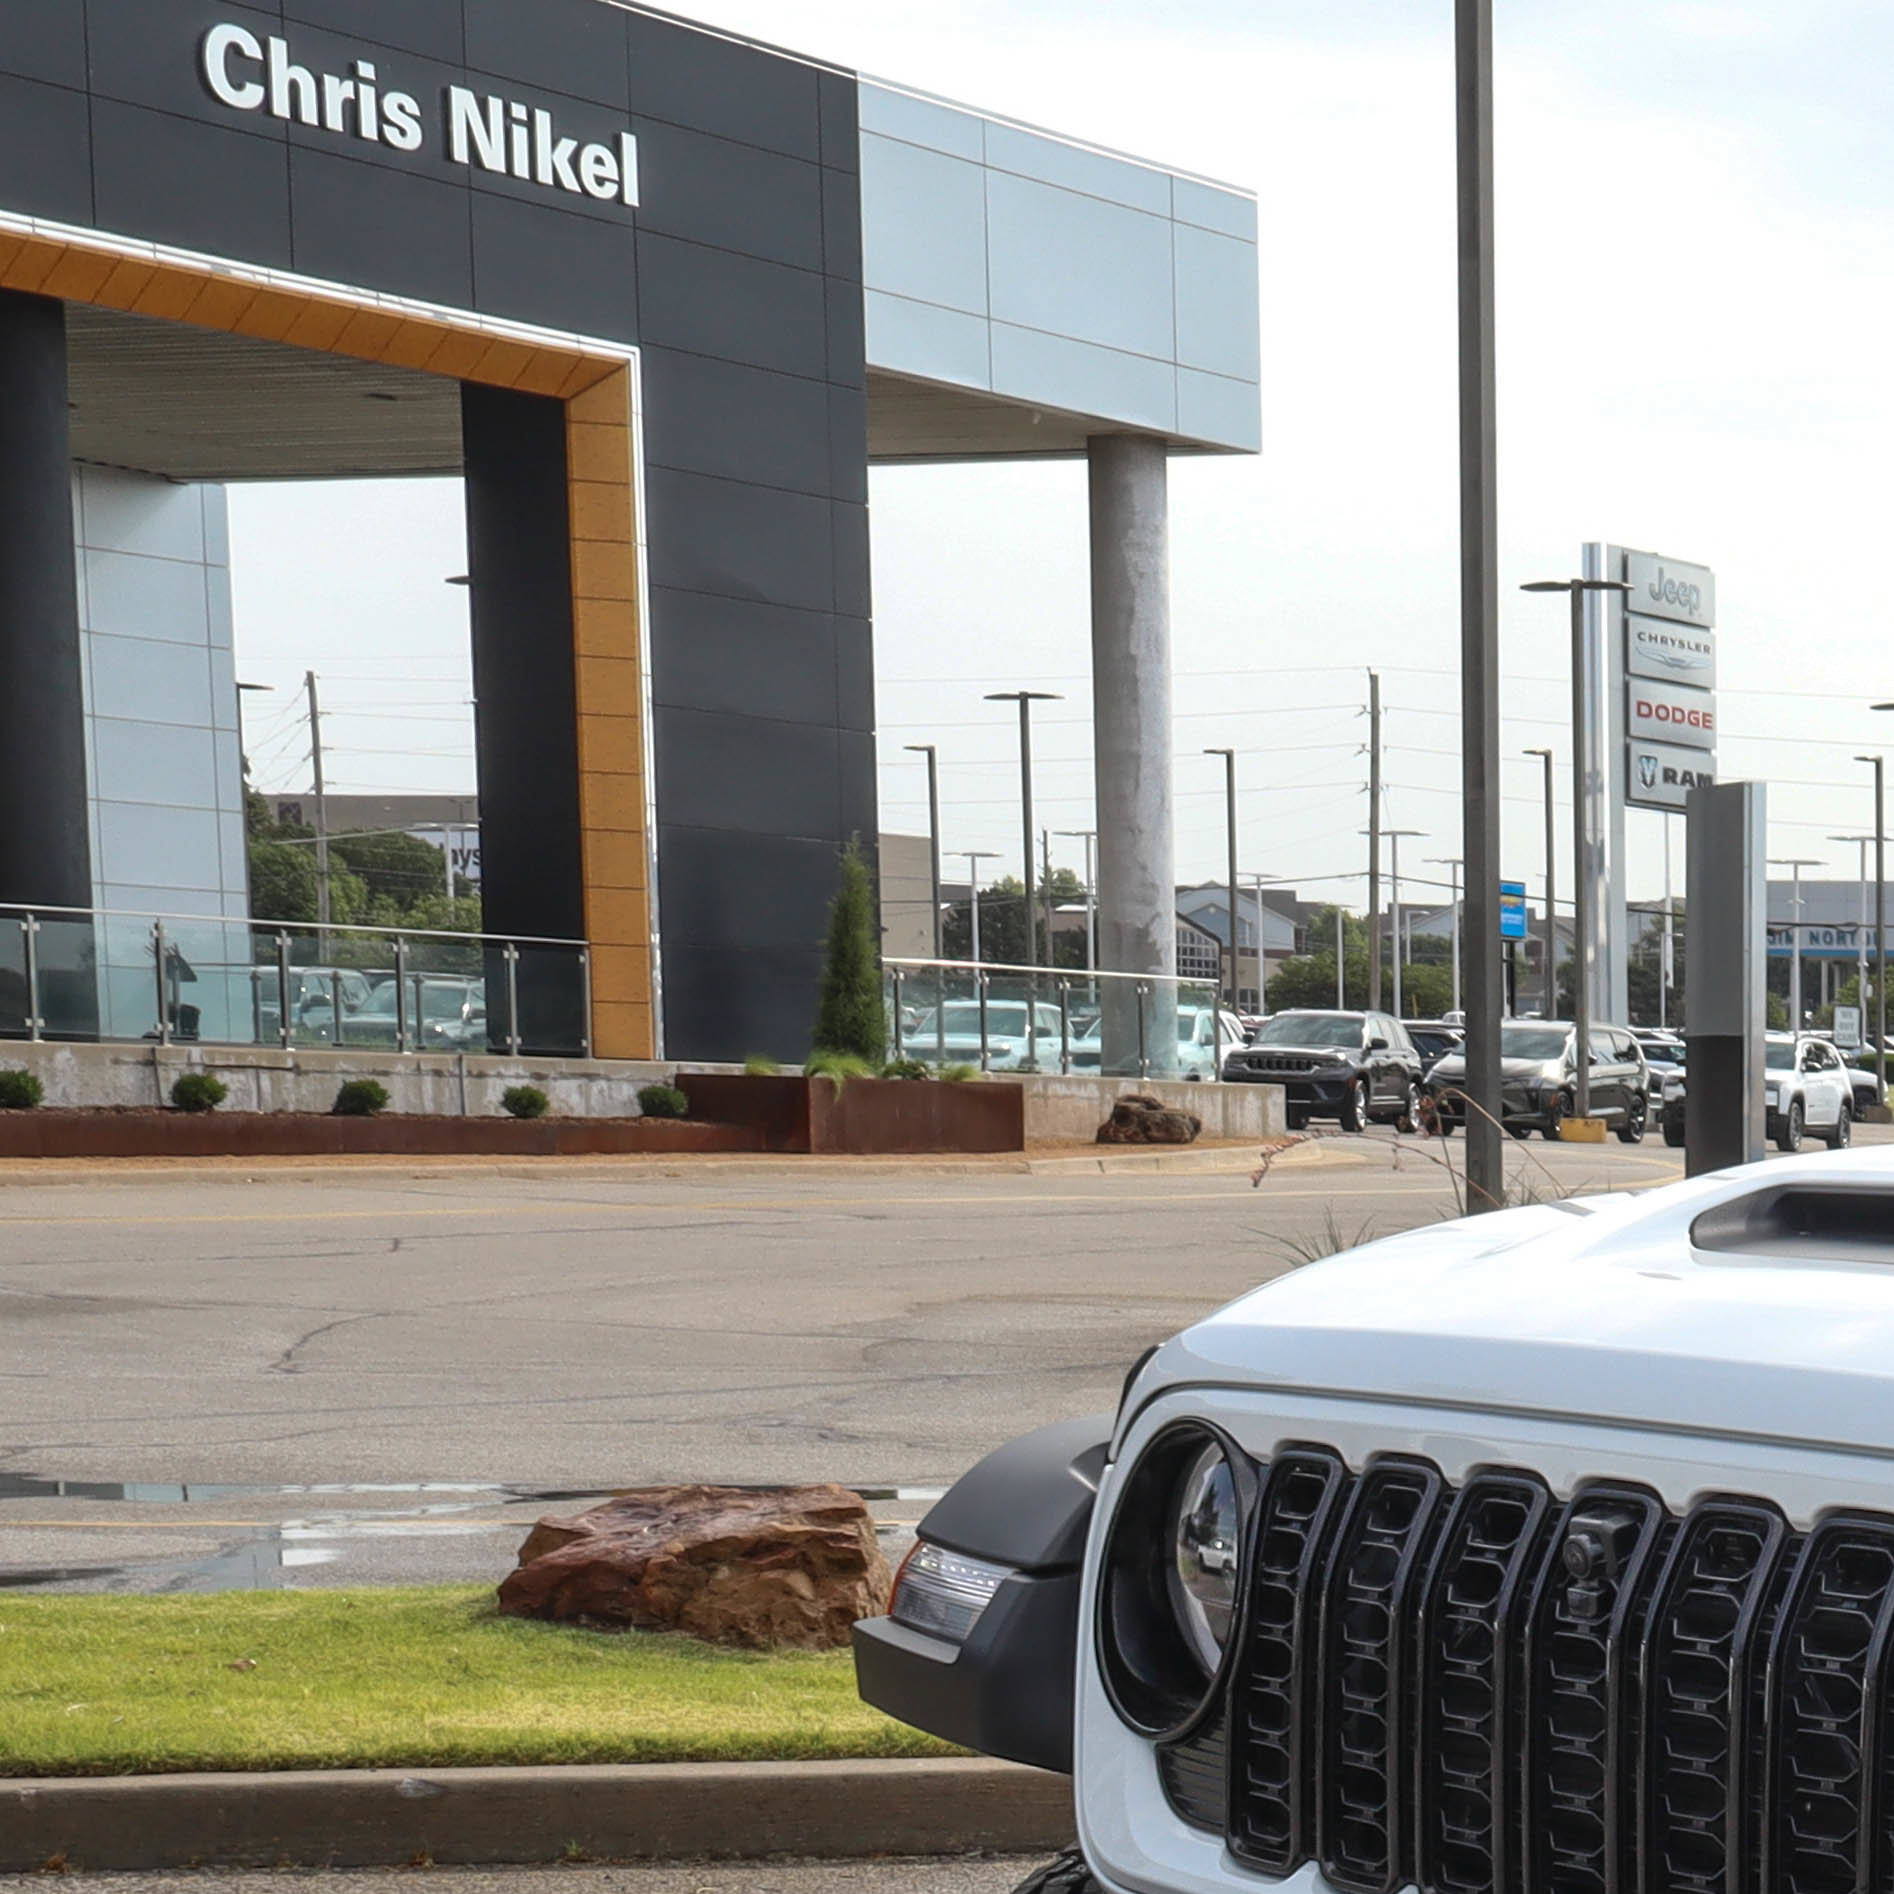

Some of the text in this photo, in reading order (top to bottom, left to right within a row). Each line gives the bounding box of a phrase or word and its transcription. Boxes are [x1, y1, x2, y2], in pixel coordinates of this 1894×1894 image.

[203, 22, 640, 207] Chris Nikel
[1648, 567, 1701, 616] Jeep
[1637, 631, 1711, 654] CHRYSLER
[1636, 700, 1713, 729] DODGE
[1662, 766, 1713, 789] RAM
[1809, 929, 1877, 945] NORT
